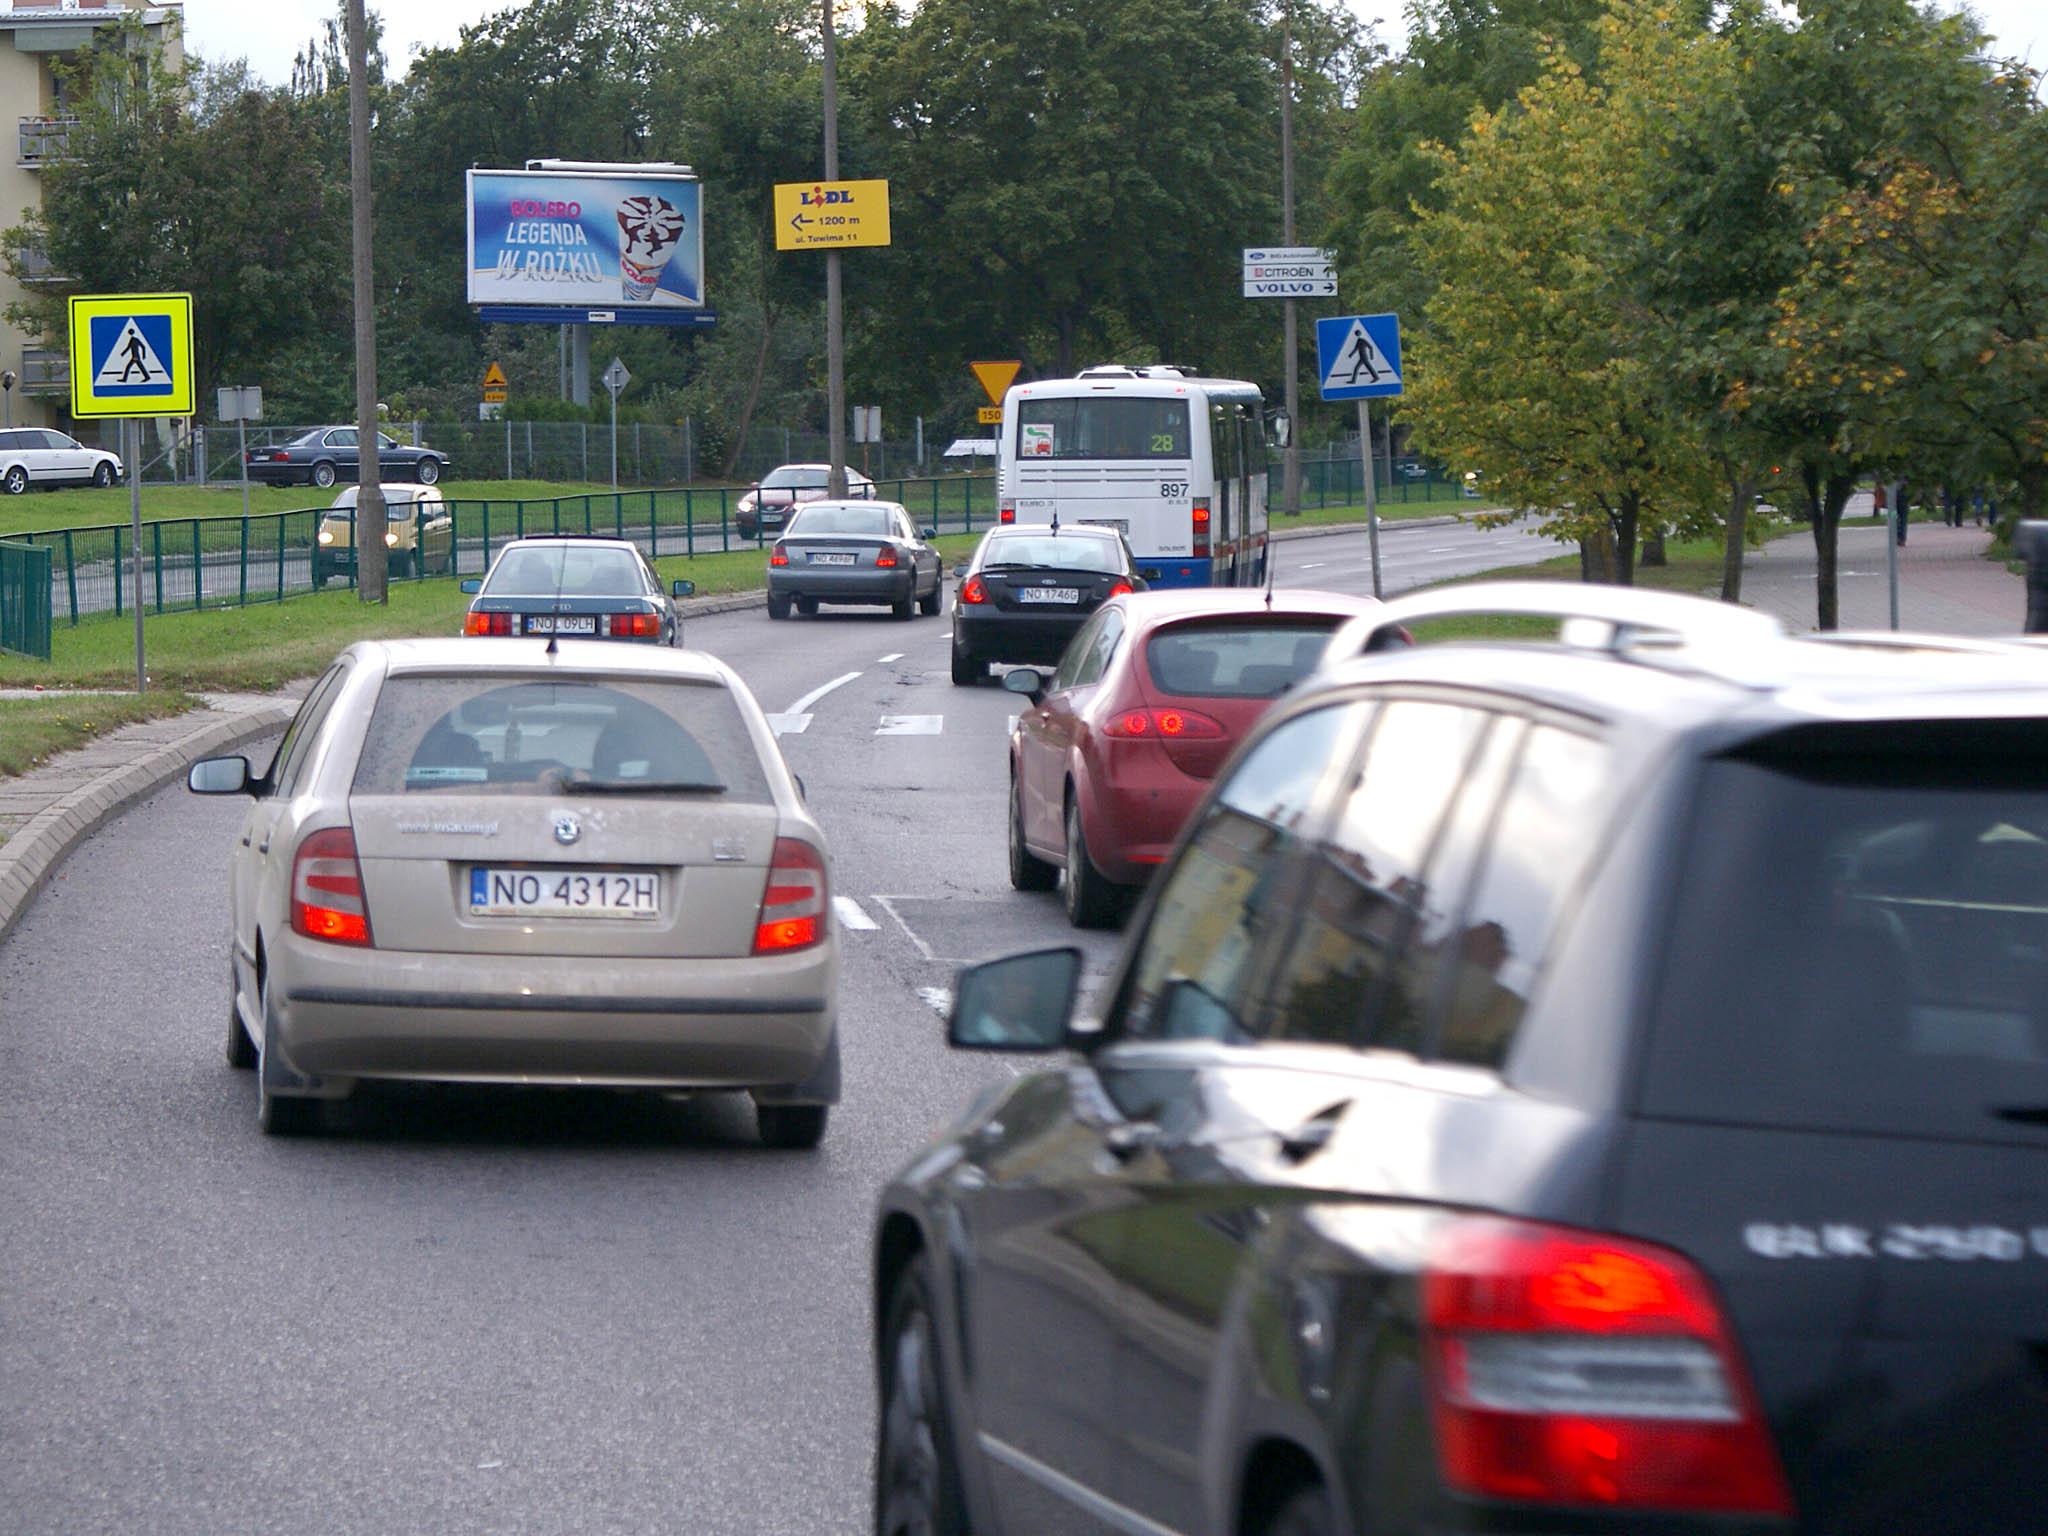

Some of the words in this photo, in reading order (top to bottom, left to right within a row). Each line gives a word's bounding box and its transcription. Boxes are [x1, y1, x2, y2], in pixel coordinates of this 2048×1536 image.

[510, 199, 582, 219] BOLERO
[819, 216, 846, 226] 1200
[849, 216, 860, 225] m
[506, 221, 588, 246] LEGENDA
[808, 234, 844, 243] Tuwima
[847, 233, 858, 241] 11
[497, 249, 521, 275] W
[524, 246, 603, 277] ROŻKU
[1256, 283, 1314, 293] VOLVO
[983, 410, 1001, 420] 150
[1151, 434, 1174, 453] 28
[1160, 483, 1190, 498] 897
[1025, 589, 1041, 600] NO
[1046, 588, 1079, 601] 1746G
[564, 616, 593, 630] 09LH
[493, 875, 541, 906] NO
[554, 876, 655, 908] 4312H
